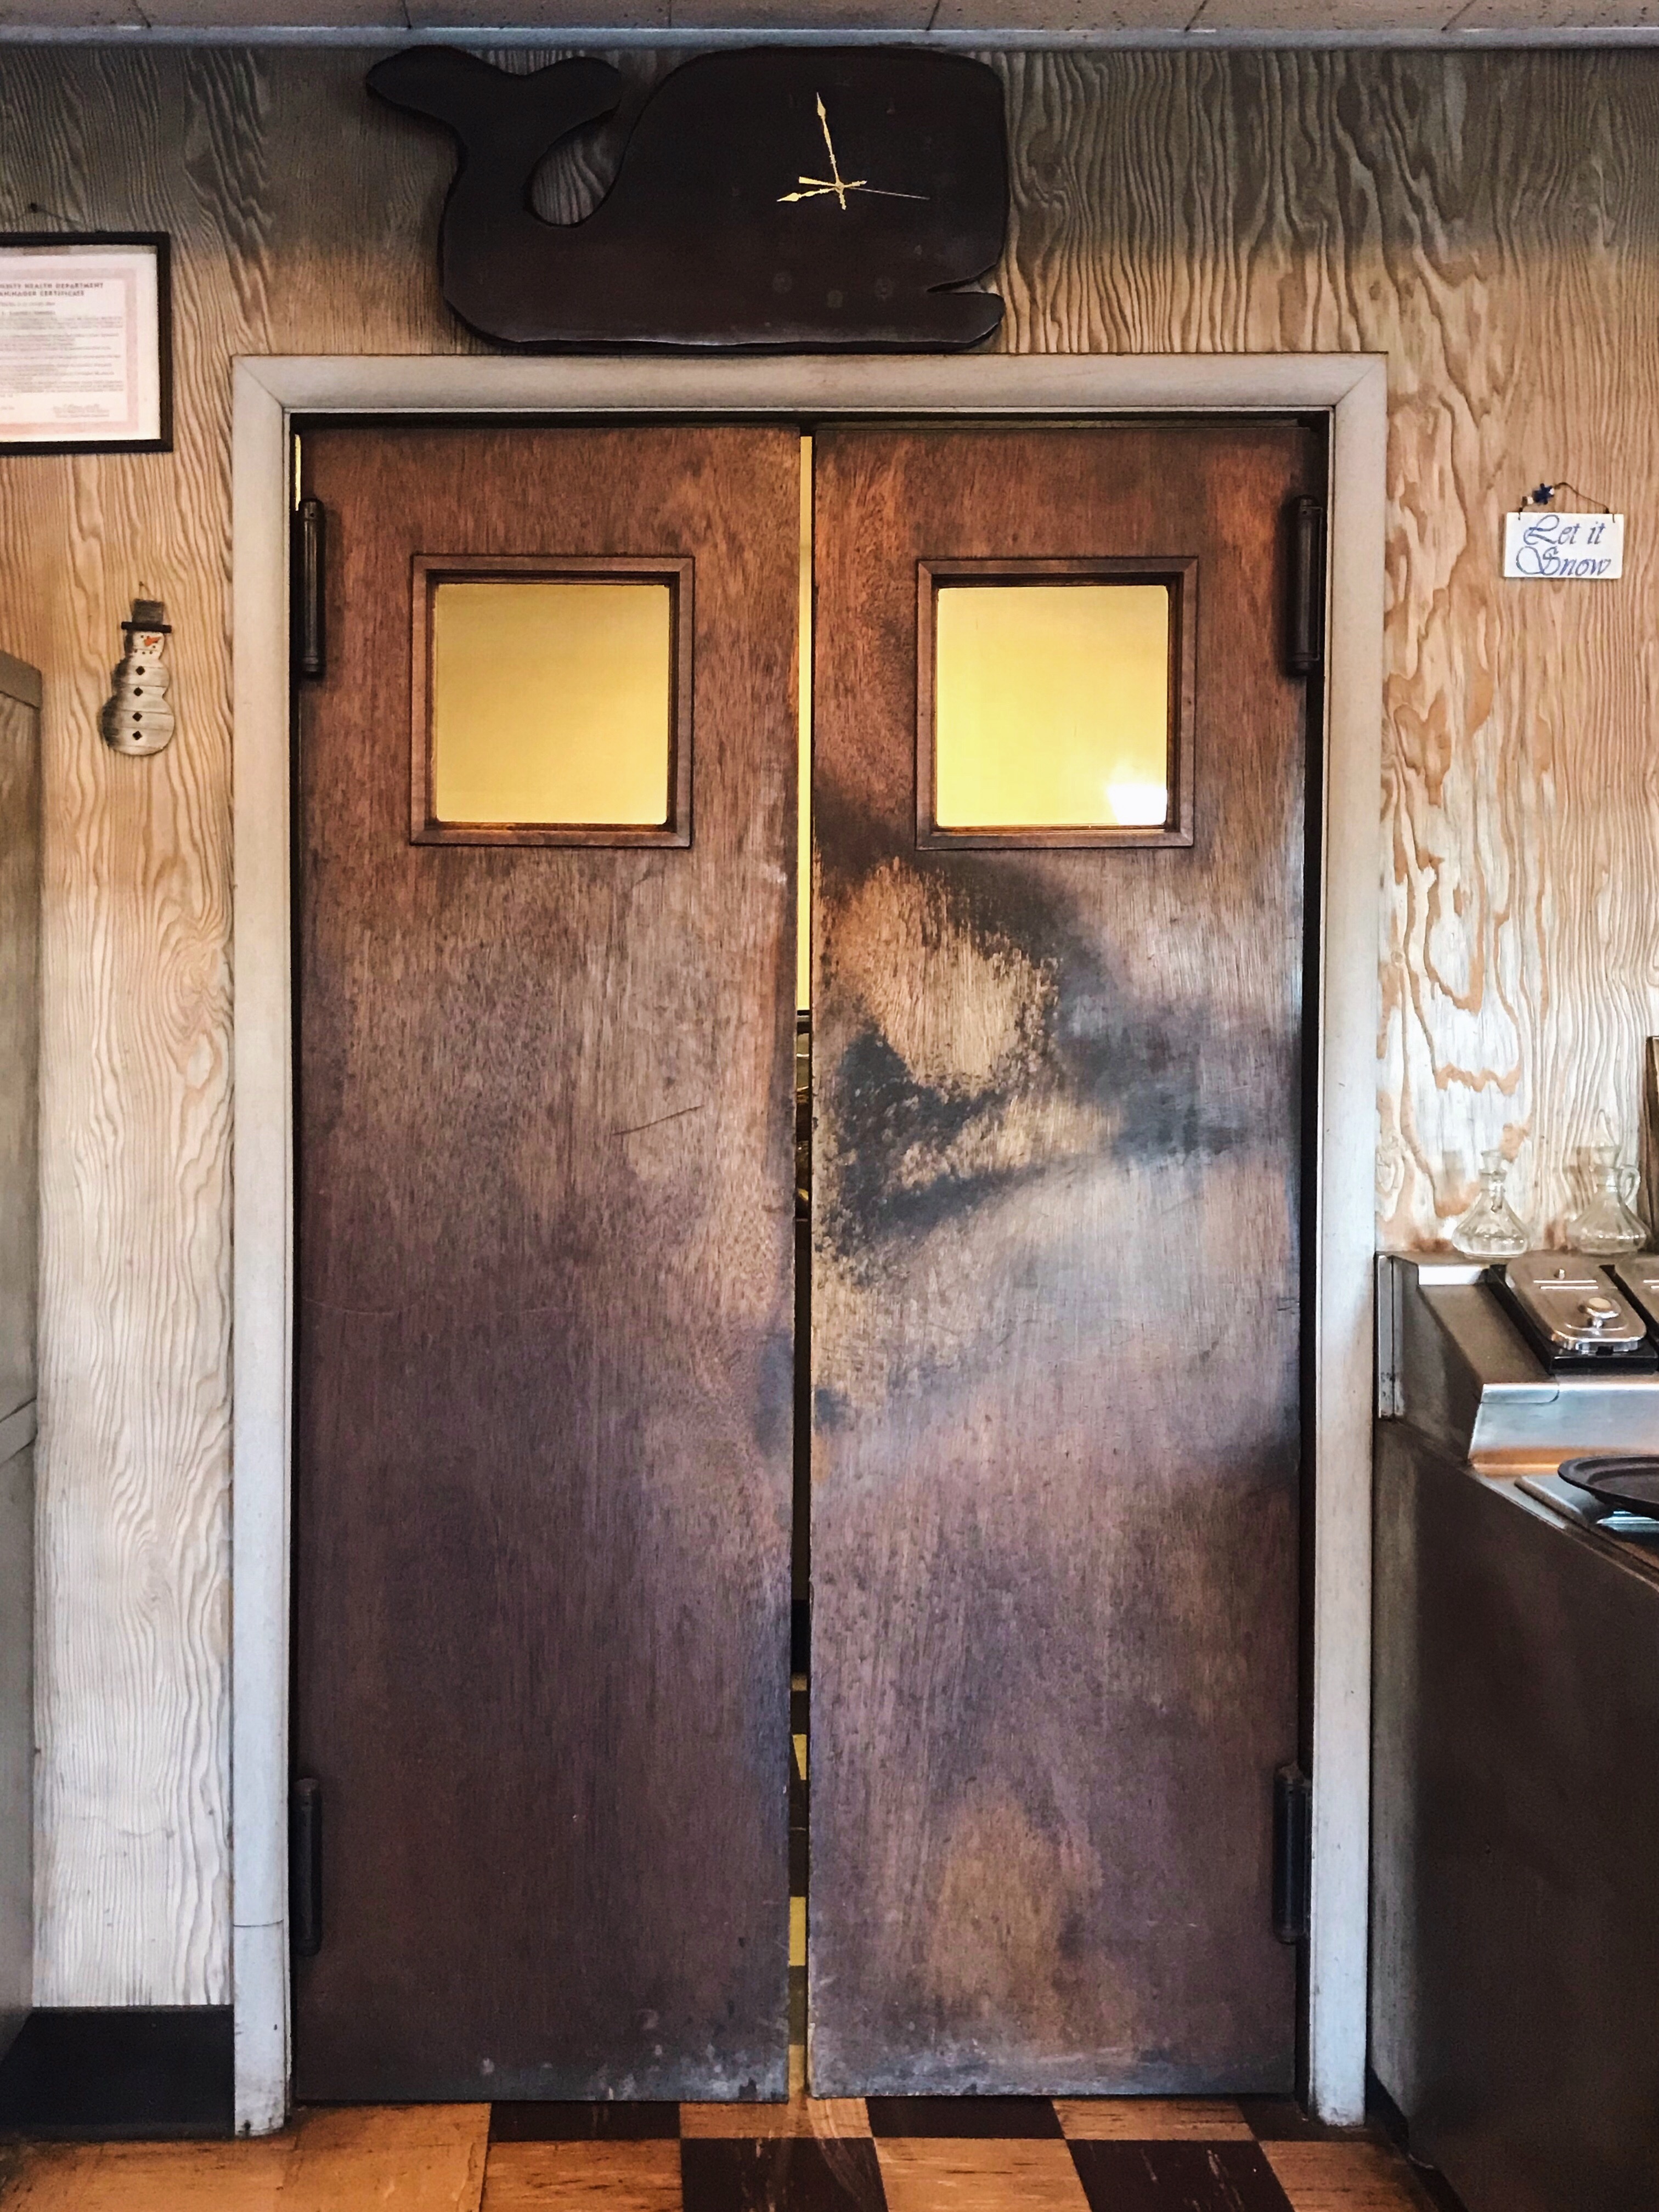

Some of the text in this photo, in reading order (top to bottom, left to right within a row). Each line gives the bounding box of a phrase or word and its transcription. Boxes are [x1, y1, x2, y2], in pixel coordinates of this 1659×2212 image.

[1523, 514, 1606, 545] Let it
[1516, 546, 1612, 576] Snow
